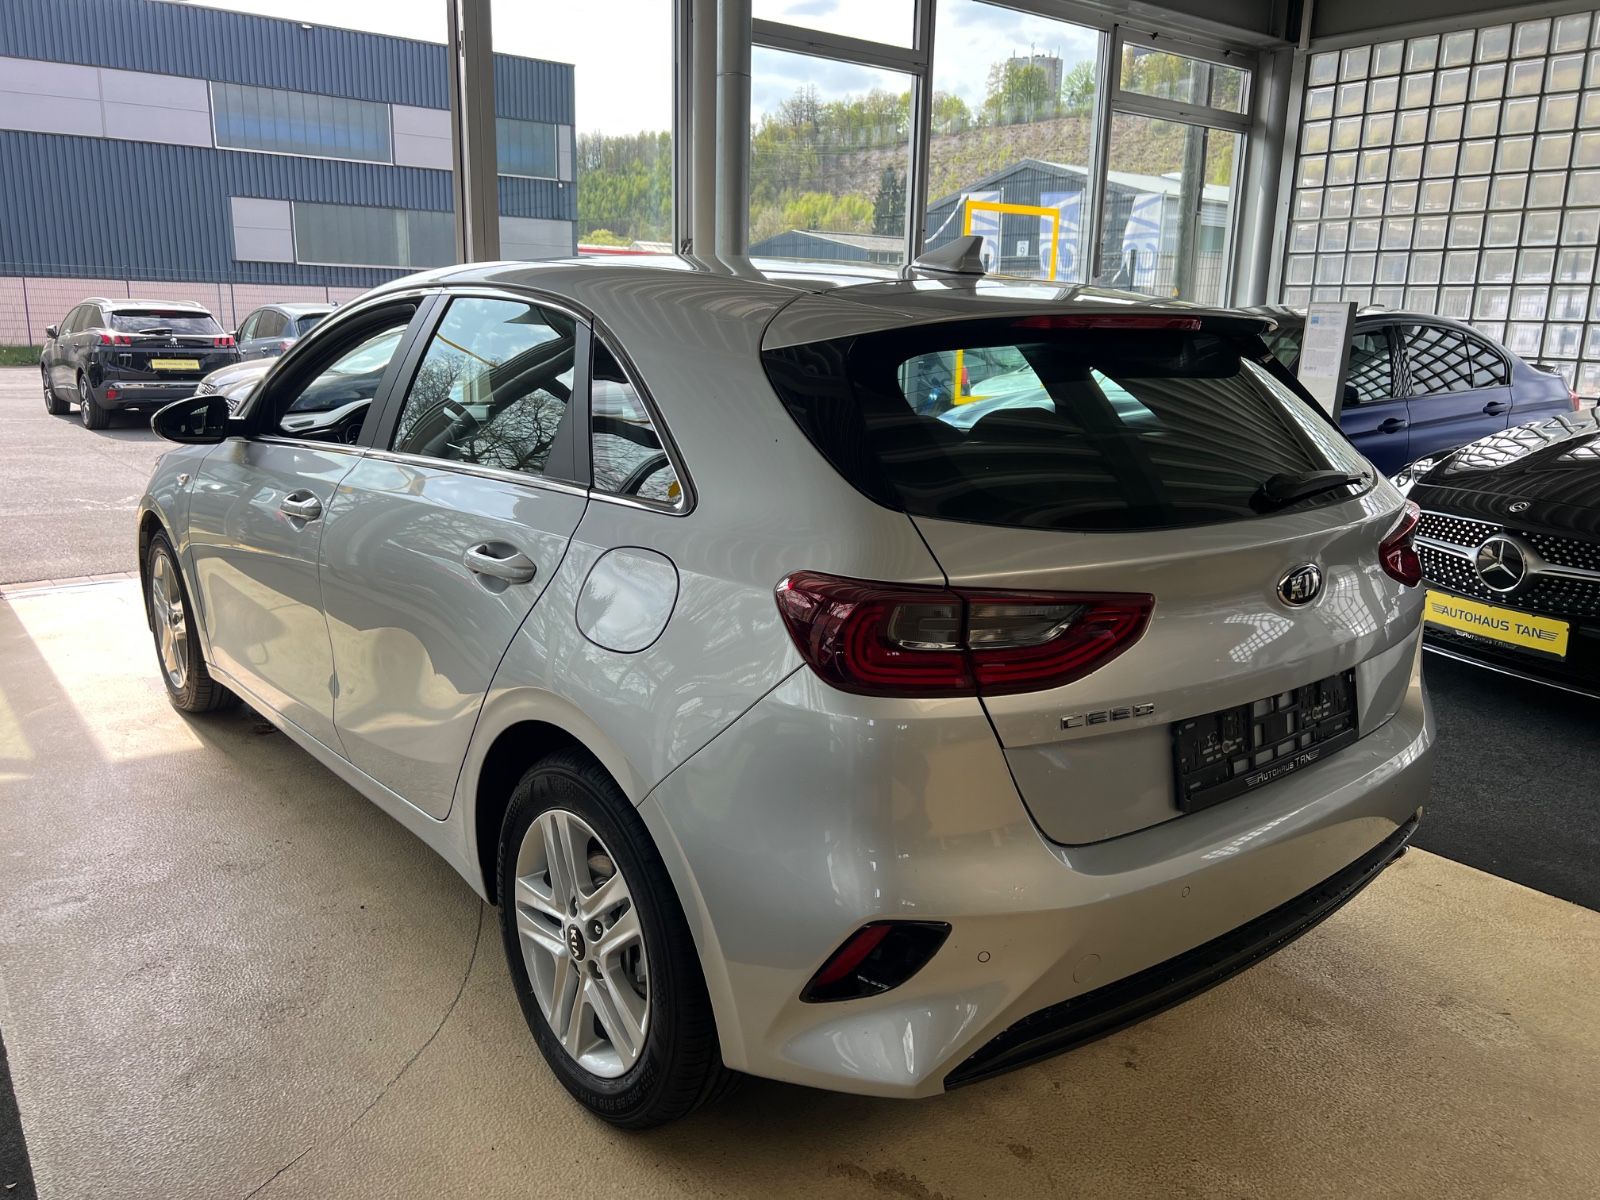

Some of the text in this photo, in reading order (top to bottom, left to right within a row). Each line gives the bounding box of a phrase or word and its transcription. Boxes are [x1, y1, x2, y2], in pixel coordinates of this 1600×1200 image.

[1441, 606, 1542, 639] AUTOHAUS TAN
[1257, 752, 1312, 783] AUTOHAUS TAN
[568, 928, 580, 957] KIA
